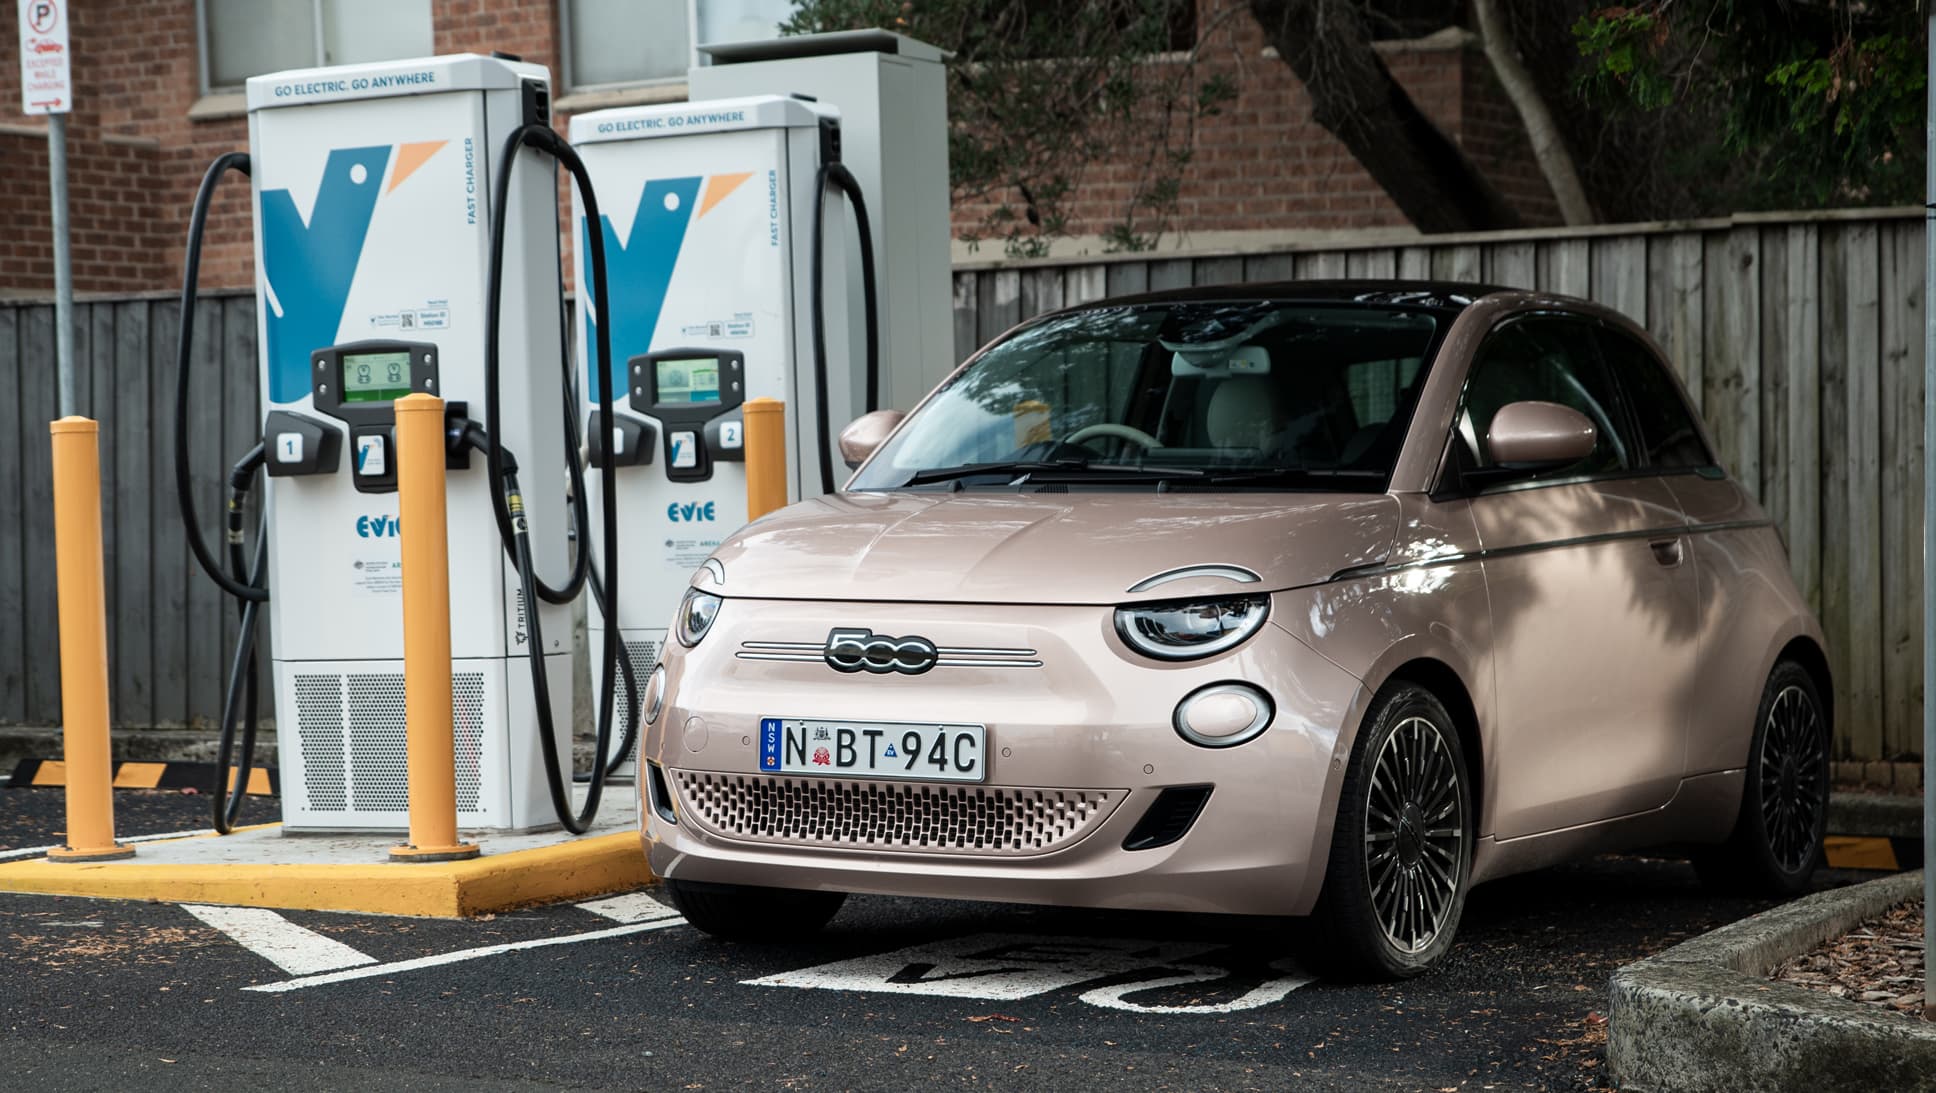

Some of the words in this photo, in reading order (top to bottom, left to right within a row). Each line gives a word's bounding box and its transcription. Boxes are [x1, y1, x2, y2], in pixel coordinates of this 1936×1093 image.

[274, 85, 292, 97] GO
[294, 79, 349, 96] ELECTRIC.
[351, 75, 370, 91] GO
[371, 71, 435, 89] ANYWHERE
[598, 123, 614, 134] GO
[615, 118, 666, 132] ELECTRIC.
[668, 116, 685, 128] GO
[686, 111, 745, 126] ANYWHERE
[464, 137, 474, 195] CHARGER
[769, 170, 777, 217] CHARGER
[468, 198, 477, 225] FAST
[286, 440, 294, 456] 1
[727, 428, 736, 442] 2
[828, 633, 933, 668] 500
[766, 721, 777, 754] NSW
